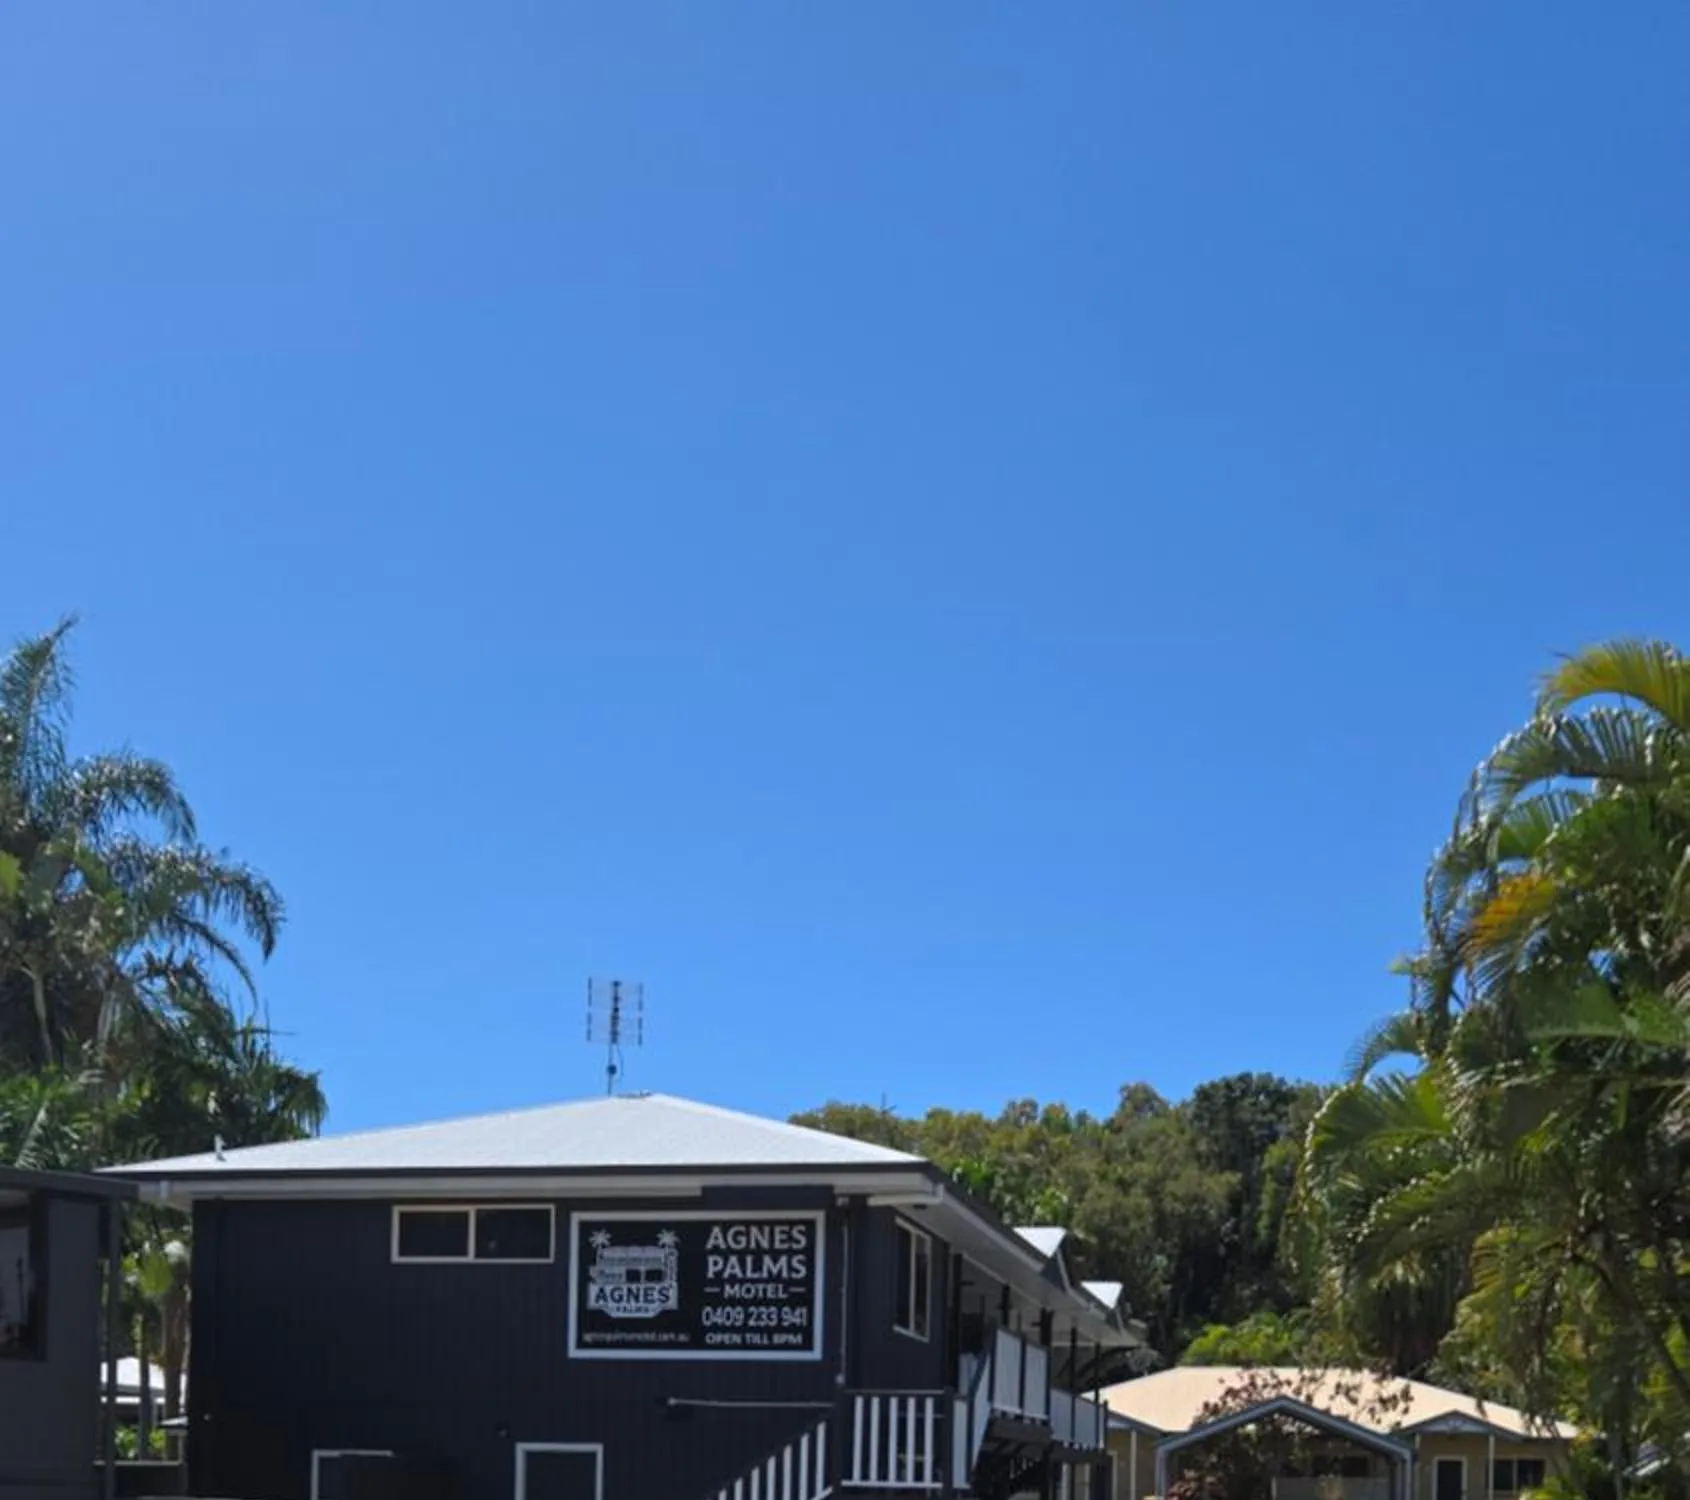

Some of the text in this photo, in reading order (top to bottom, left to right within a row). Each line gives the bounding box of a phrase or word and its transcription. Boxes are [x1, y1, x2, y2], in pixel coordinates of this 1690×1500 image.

[705, 1225, 807, 1251] AGNES
[706, 1254, 807, 1280] PALMS
[594, 1286, 671, 1305] AGNES
[723, 1283, 788, 1300] MOTEL
[701, 1305, 808, 1327] 0409 233 941
[704, 1331, 742, 1345] OPEN
[744, 1331, 770, 1345] TILL
